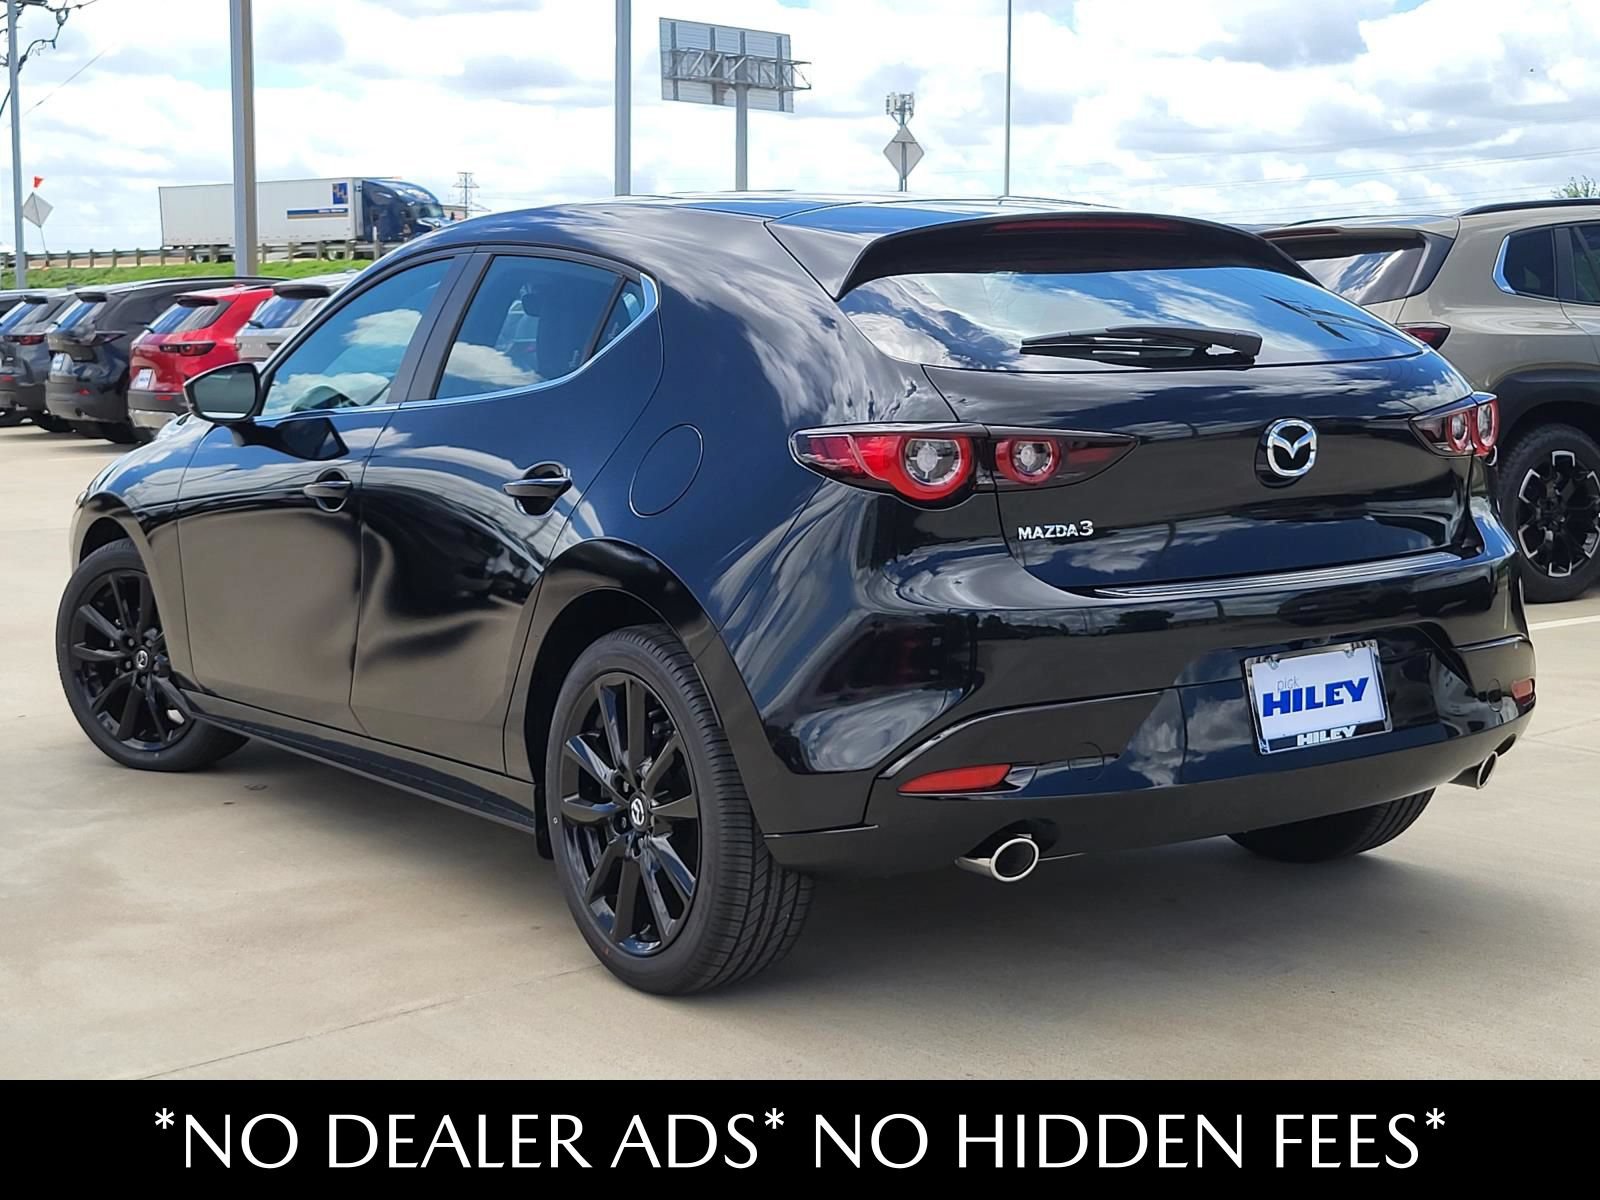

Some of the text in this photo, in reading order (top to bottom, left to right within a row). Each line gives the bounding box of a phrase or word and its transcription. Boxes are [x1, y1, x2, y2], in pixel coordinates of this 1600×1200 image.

[1017, 519, 1095, 541] MAZDA3
[1276, 675, 1301, 691] pick
[1262, 676, 1370, 718] HILEY
[1296, 725, 1358, 747] HILEY
